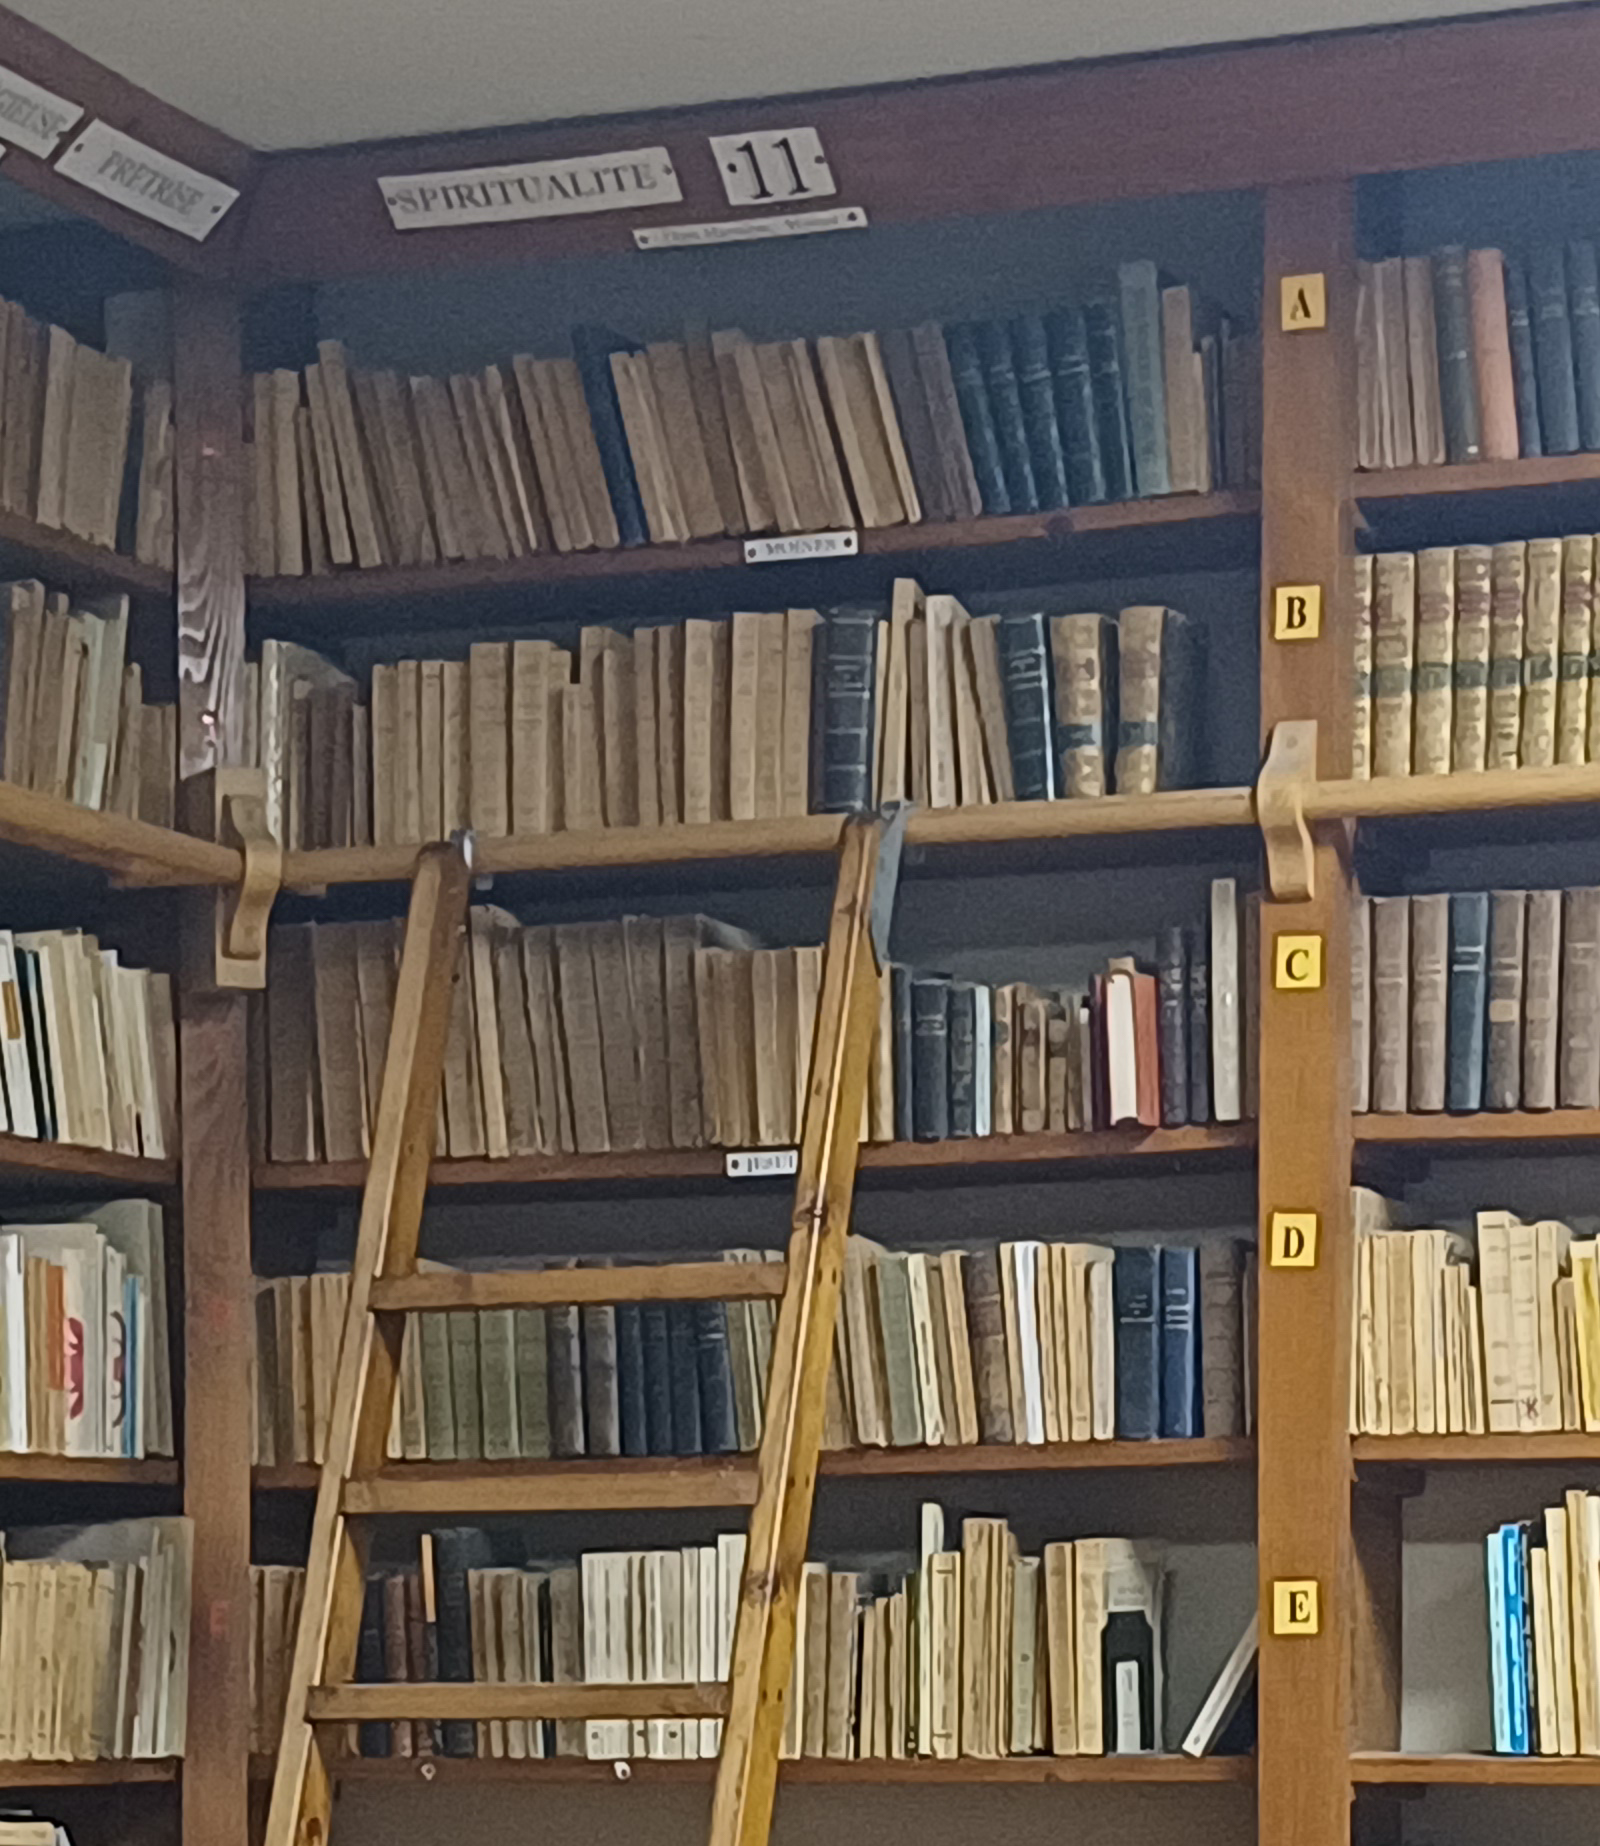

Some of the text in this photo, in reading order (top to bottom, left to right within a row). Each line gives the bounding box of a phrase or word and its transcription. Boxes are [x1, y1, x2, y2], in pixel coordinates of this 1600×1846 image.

[735, 136, 812, 200] 11
[395, 163, 657, 215] SPIRITUALITE
[1291, 288, 1311, 319] A
[1287, 597, 1306, 629] B
[1286, 949, 1308, 981] C
[1283, 1227, 1304, 1258] D
[1289, 1591, 1310, 1623] E
